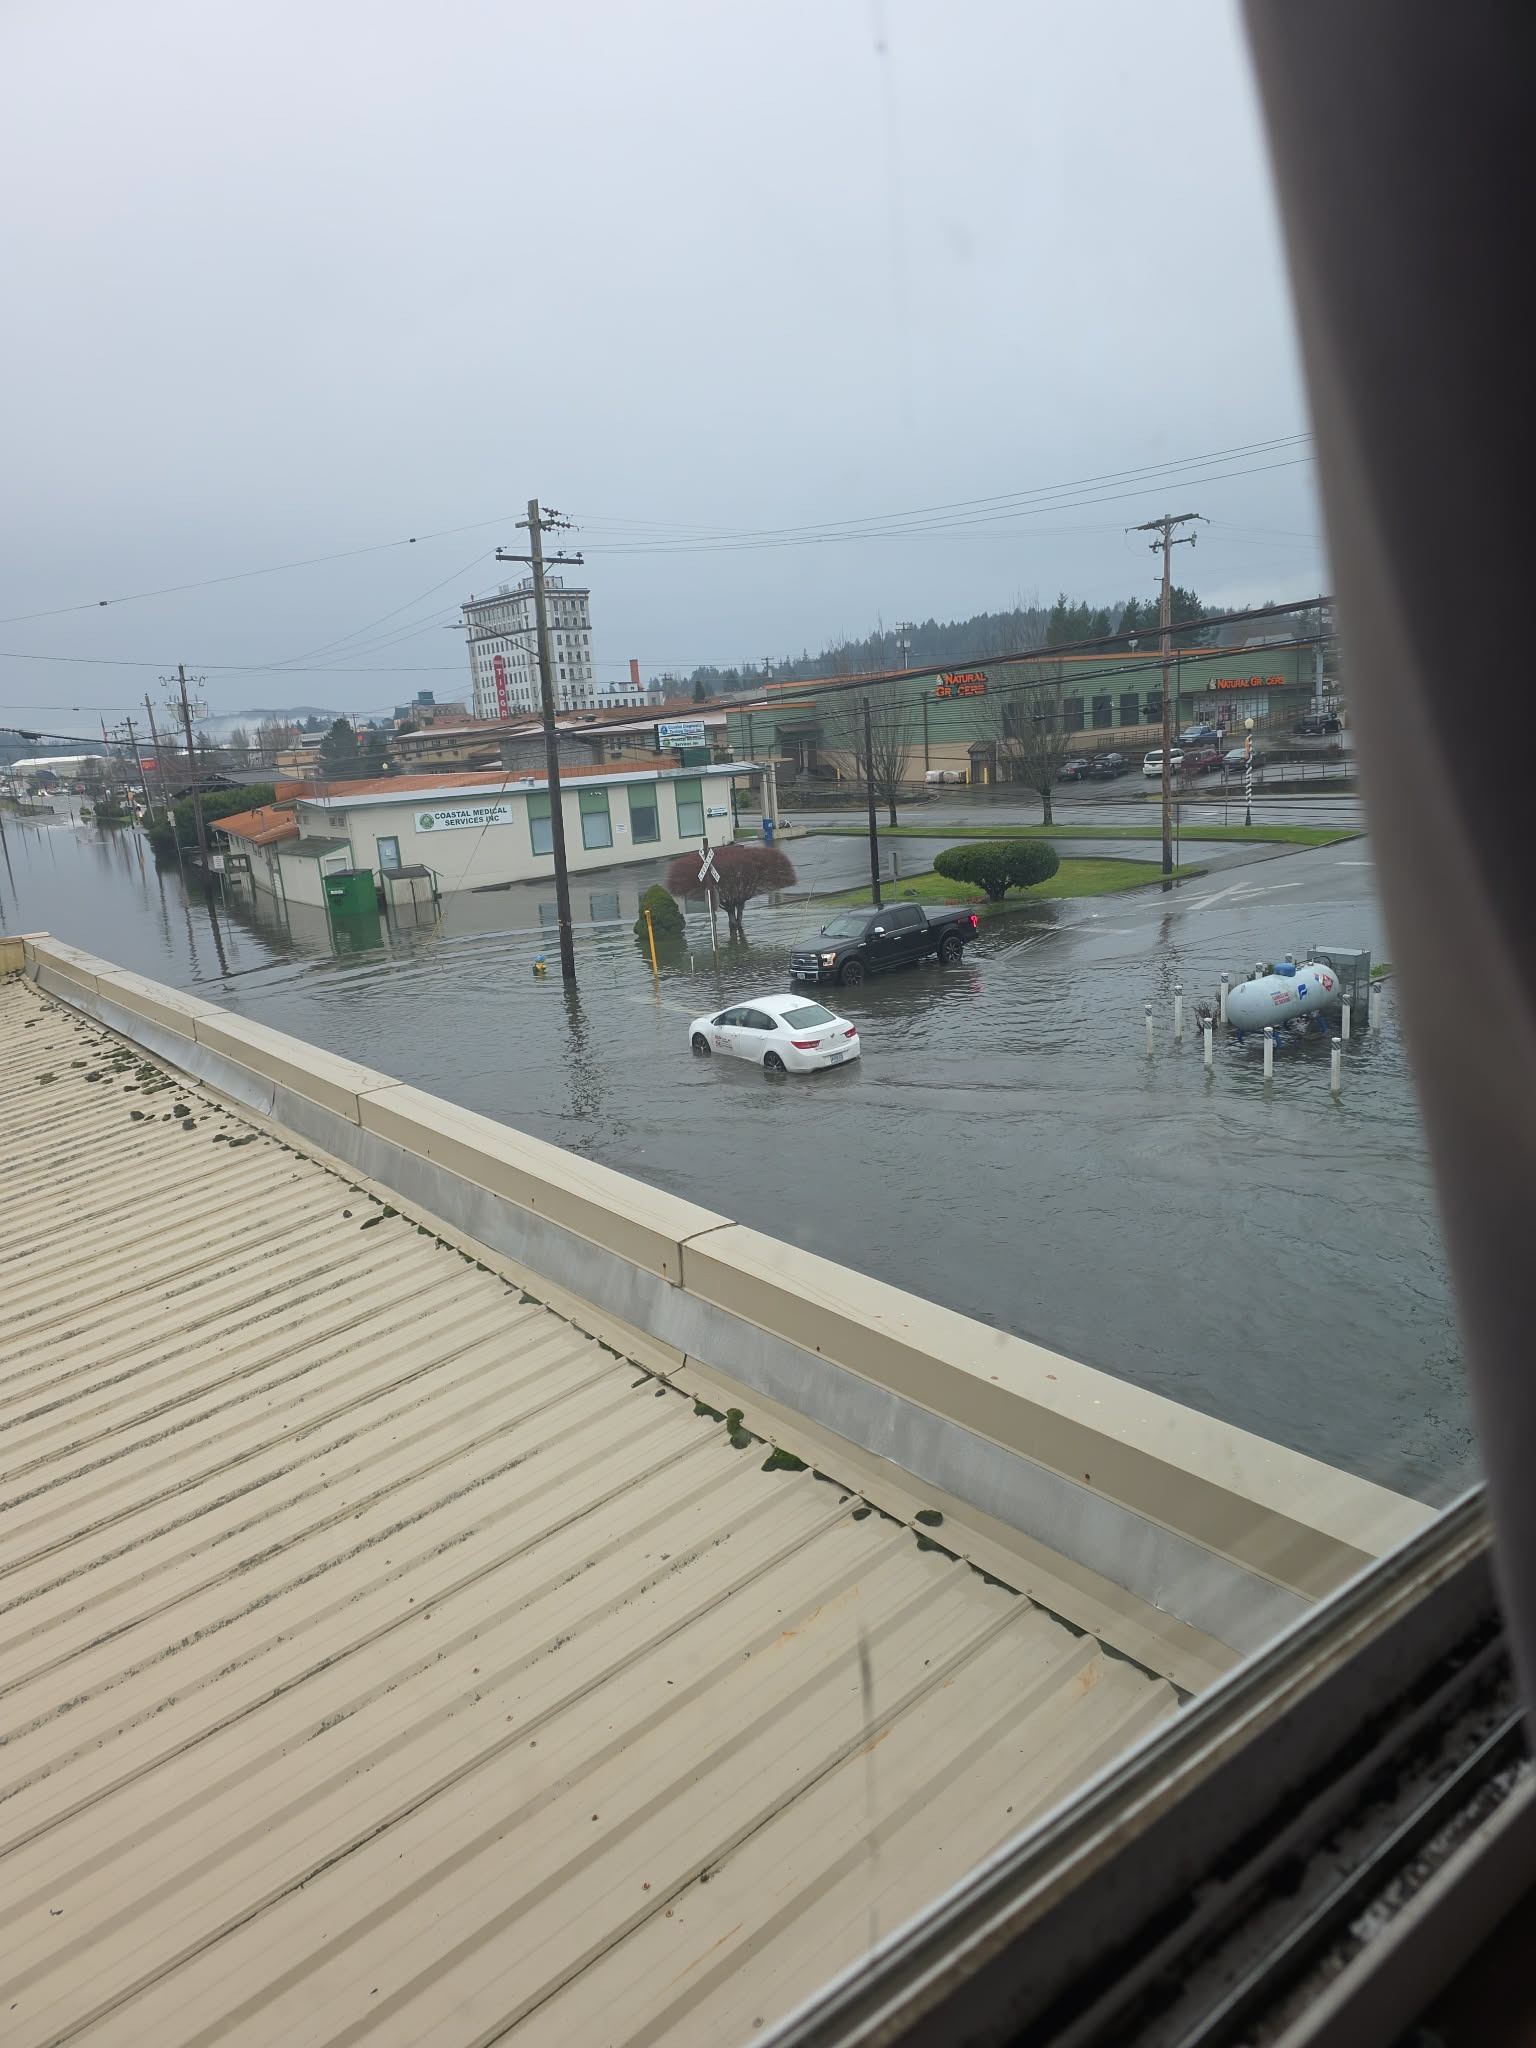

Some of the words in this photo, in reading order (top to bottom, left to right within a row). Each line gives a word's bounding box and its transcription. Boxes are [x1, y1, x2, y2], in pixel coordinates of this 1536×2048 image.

[945, 672, 987, 684] NATURAL
[1217, 678, 1250, 689] NATURAL
[496, 668, 508, 717] TIOGA
[434, 810, 471, 820] COASTAL
[473, 806, 508, 816] MEDICAL
[445, 816, 484, 826] SERVICES
